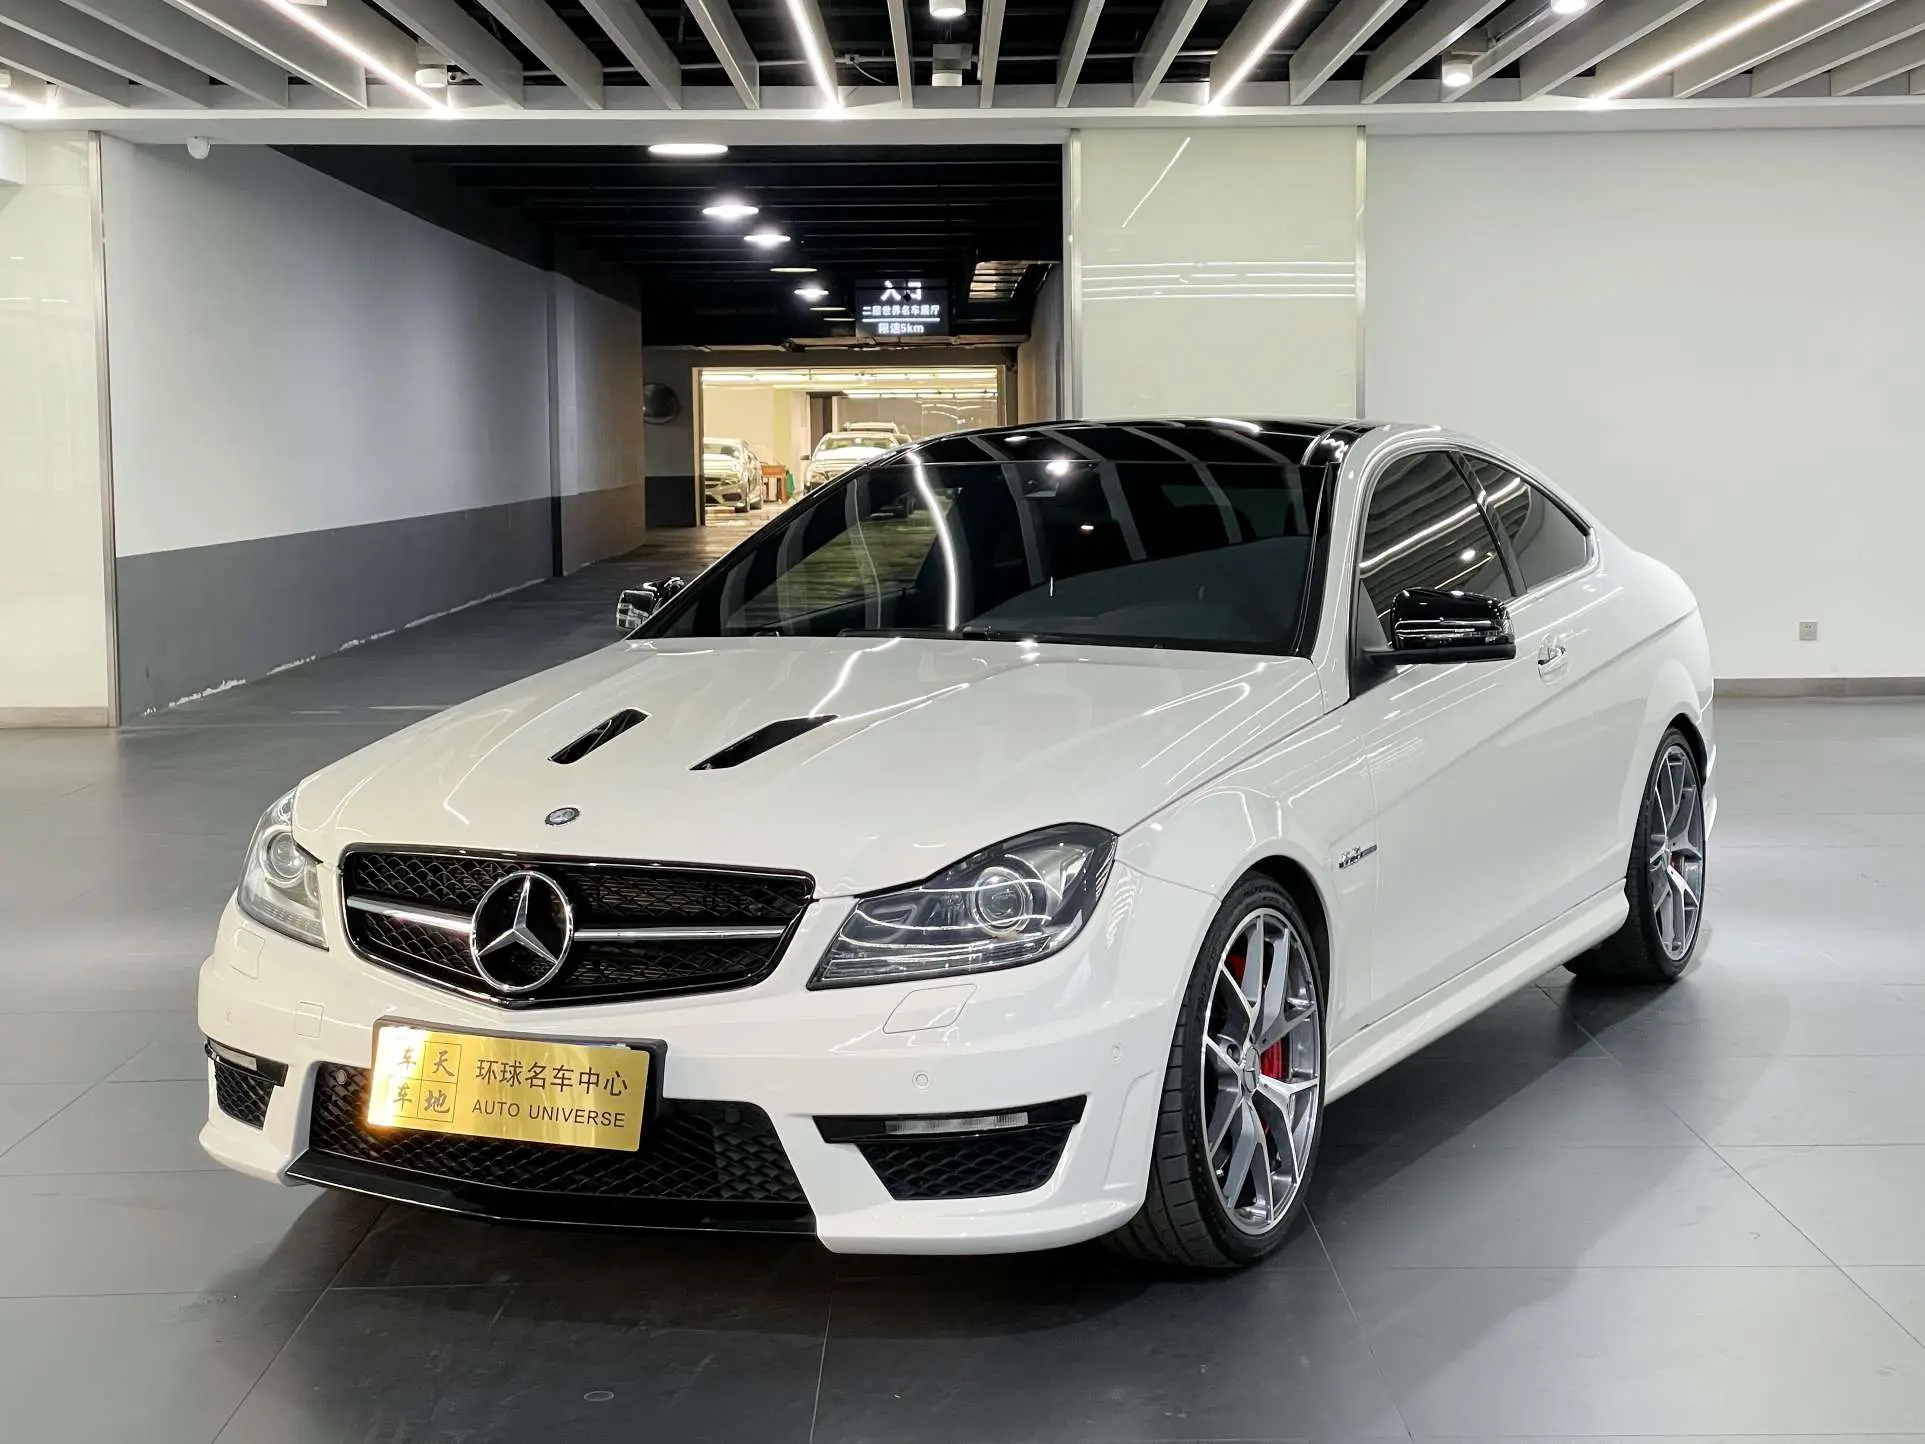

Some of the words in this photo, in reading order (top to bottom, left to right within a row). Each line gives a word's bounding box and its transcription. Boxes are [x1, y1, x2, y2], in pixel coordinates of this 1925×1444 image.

[475, 1058, 629, 1097] 环球名车中心
[472, 1099, 521, 1118] AUTO
[529, 1105, 626, 1128] UNIVERSE
